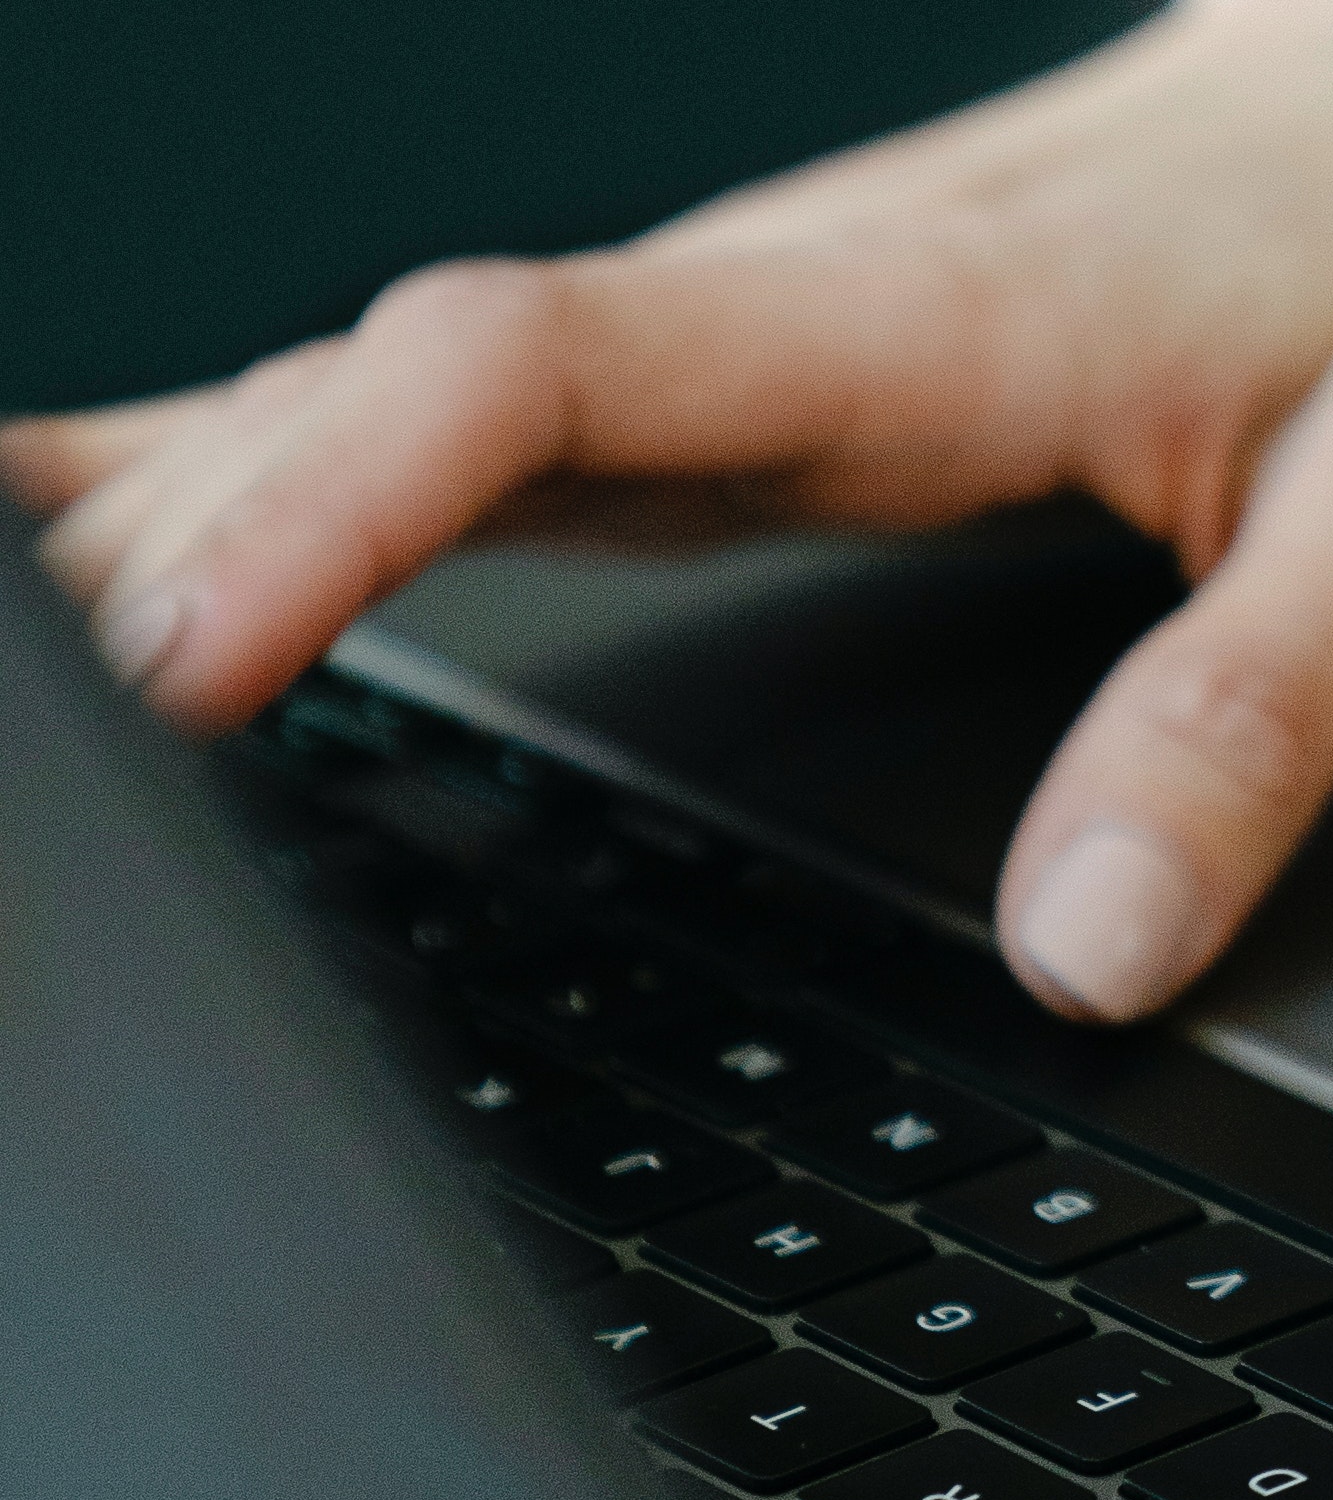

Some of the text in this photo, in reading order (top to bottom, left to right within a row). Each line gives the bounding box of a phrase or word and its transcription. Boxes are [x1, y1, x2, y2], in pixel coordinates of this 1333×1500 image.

[604, 1150, 664, 1175] J
[1032, 1190, 1094, 1224] B
[753, 1224, 820, 1257] H
[1186, 1269, 1246, 1301] V
[914, 1302, 975, 1334] G
[594, 1322, 650, 1352] Y
[749, 1403, 807, 1433] T
[1075, 1390, 1138, 1416] F
[1246, 1466, 1309, 1499] D
